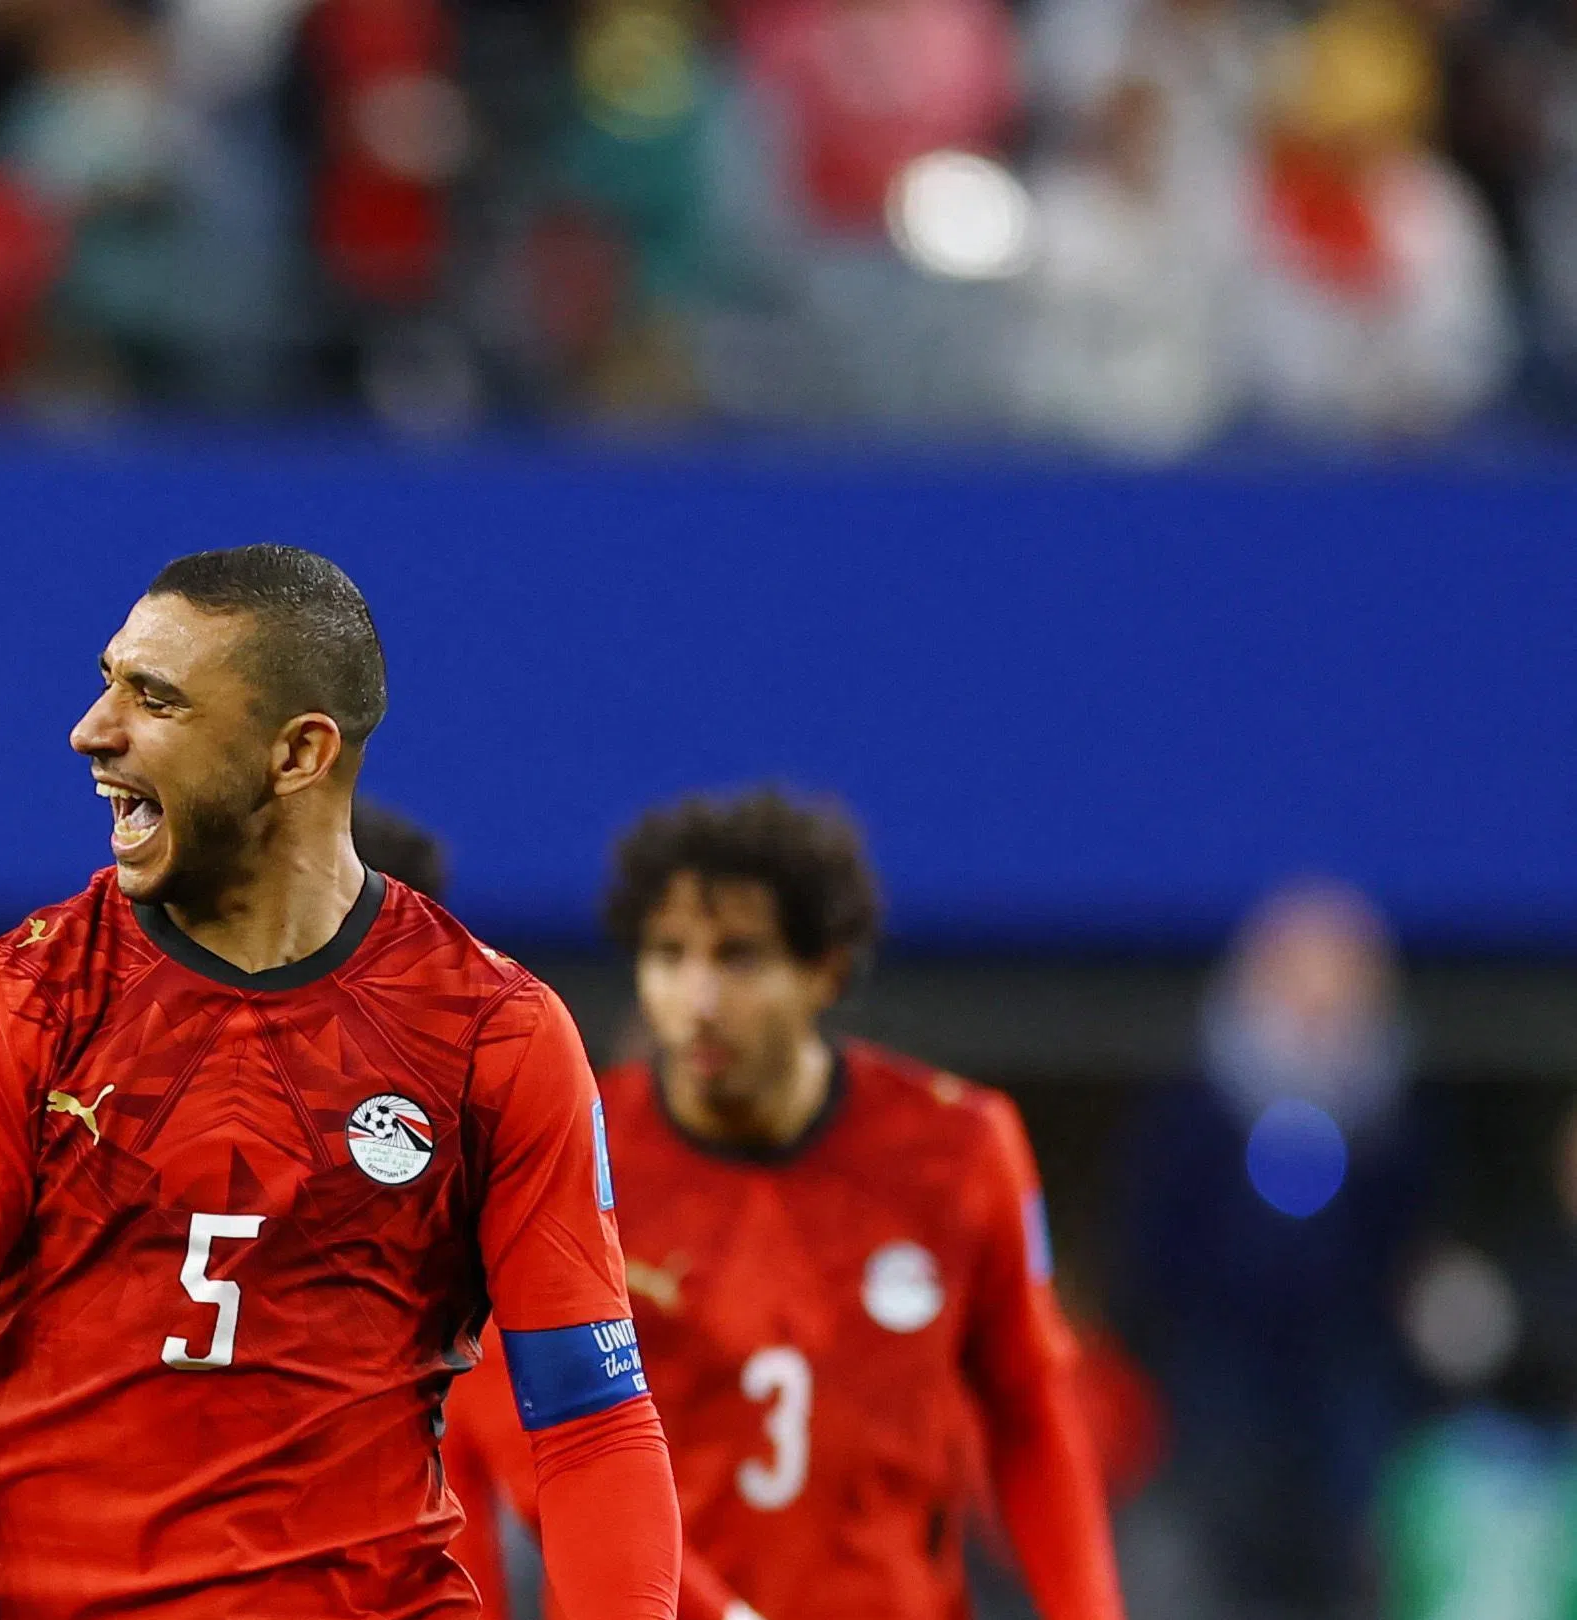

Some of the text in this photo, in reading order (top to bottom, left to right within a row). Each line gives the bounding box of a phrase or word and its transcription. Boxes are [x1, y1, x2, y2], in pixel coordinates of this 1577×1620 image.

[161, 1212, 267, 1370] 5
[600, 1353, 631, 1378] the
[737, 1344, 813, 1511] 3
